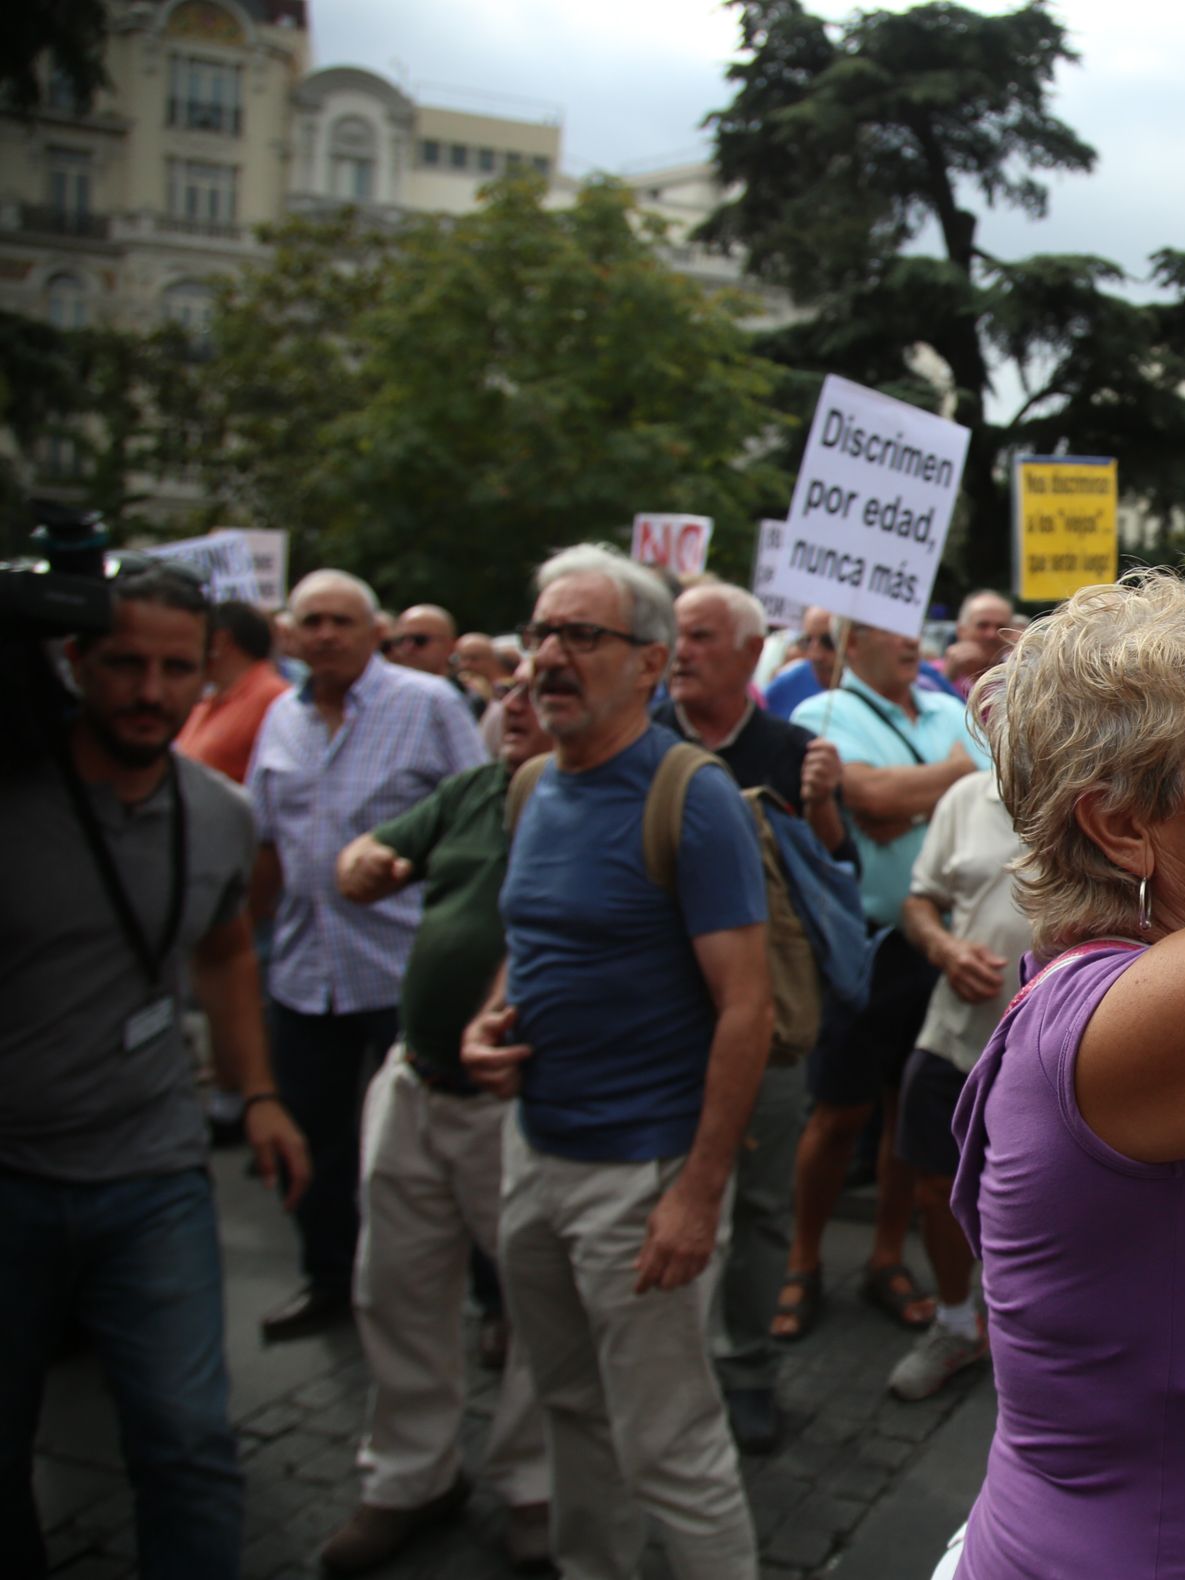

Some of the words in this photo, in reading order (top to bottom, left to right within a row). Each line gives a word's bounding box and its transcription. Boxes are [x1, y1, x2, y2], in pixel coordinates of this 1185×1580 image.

[821, 408, 955, 487] Discrimen
[639, 522, 704, 573] NO
[803, 478, 858, 519] por
[863, 495, 937, 552] edad,
[789, 539, 866, 587] nunca
[869, 561, 922, 606] más.
